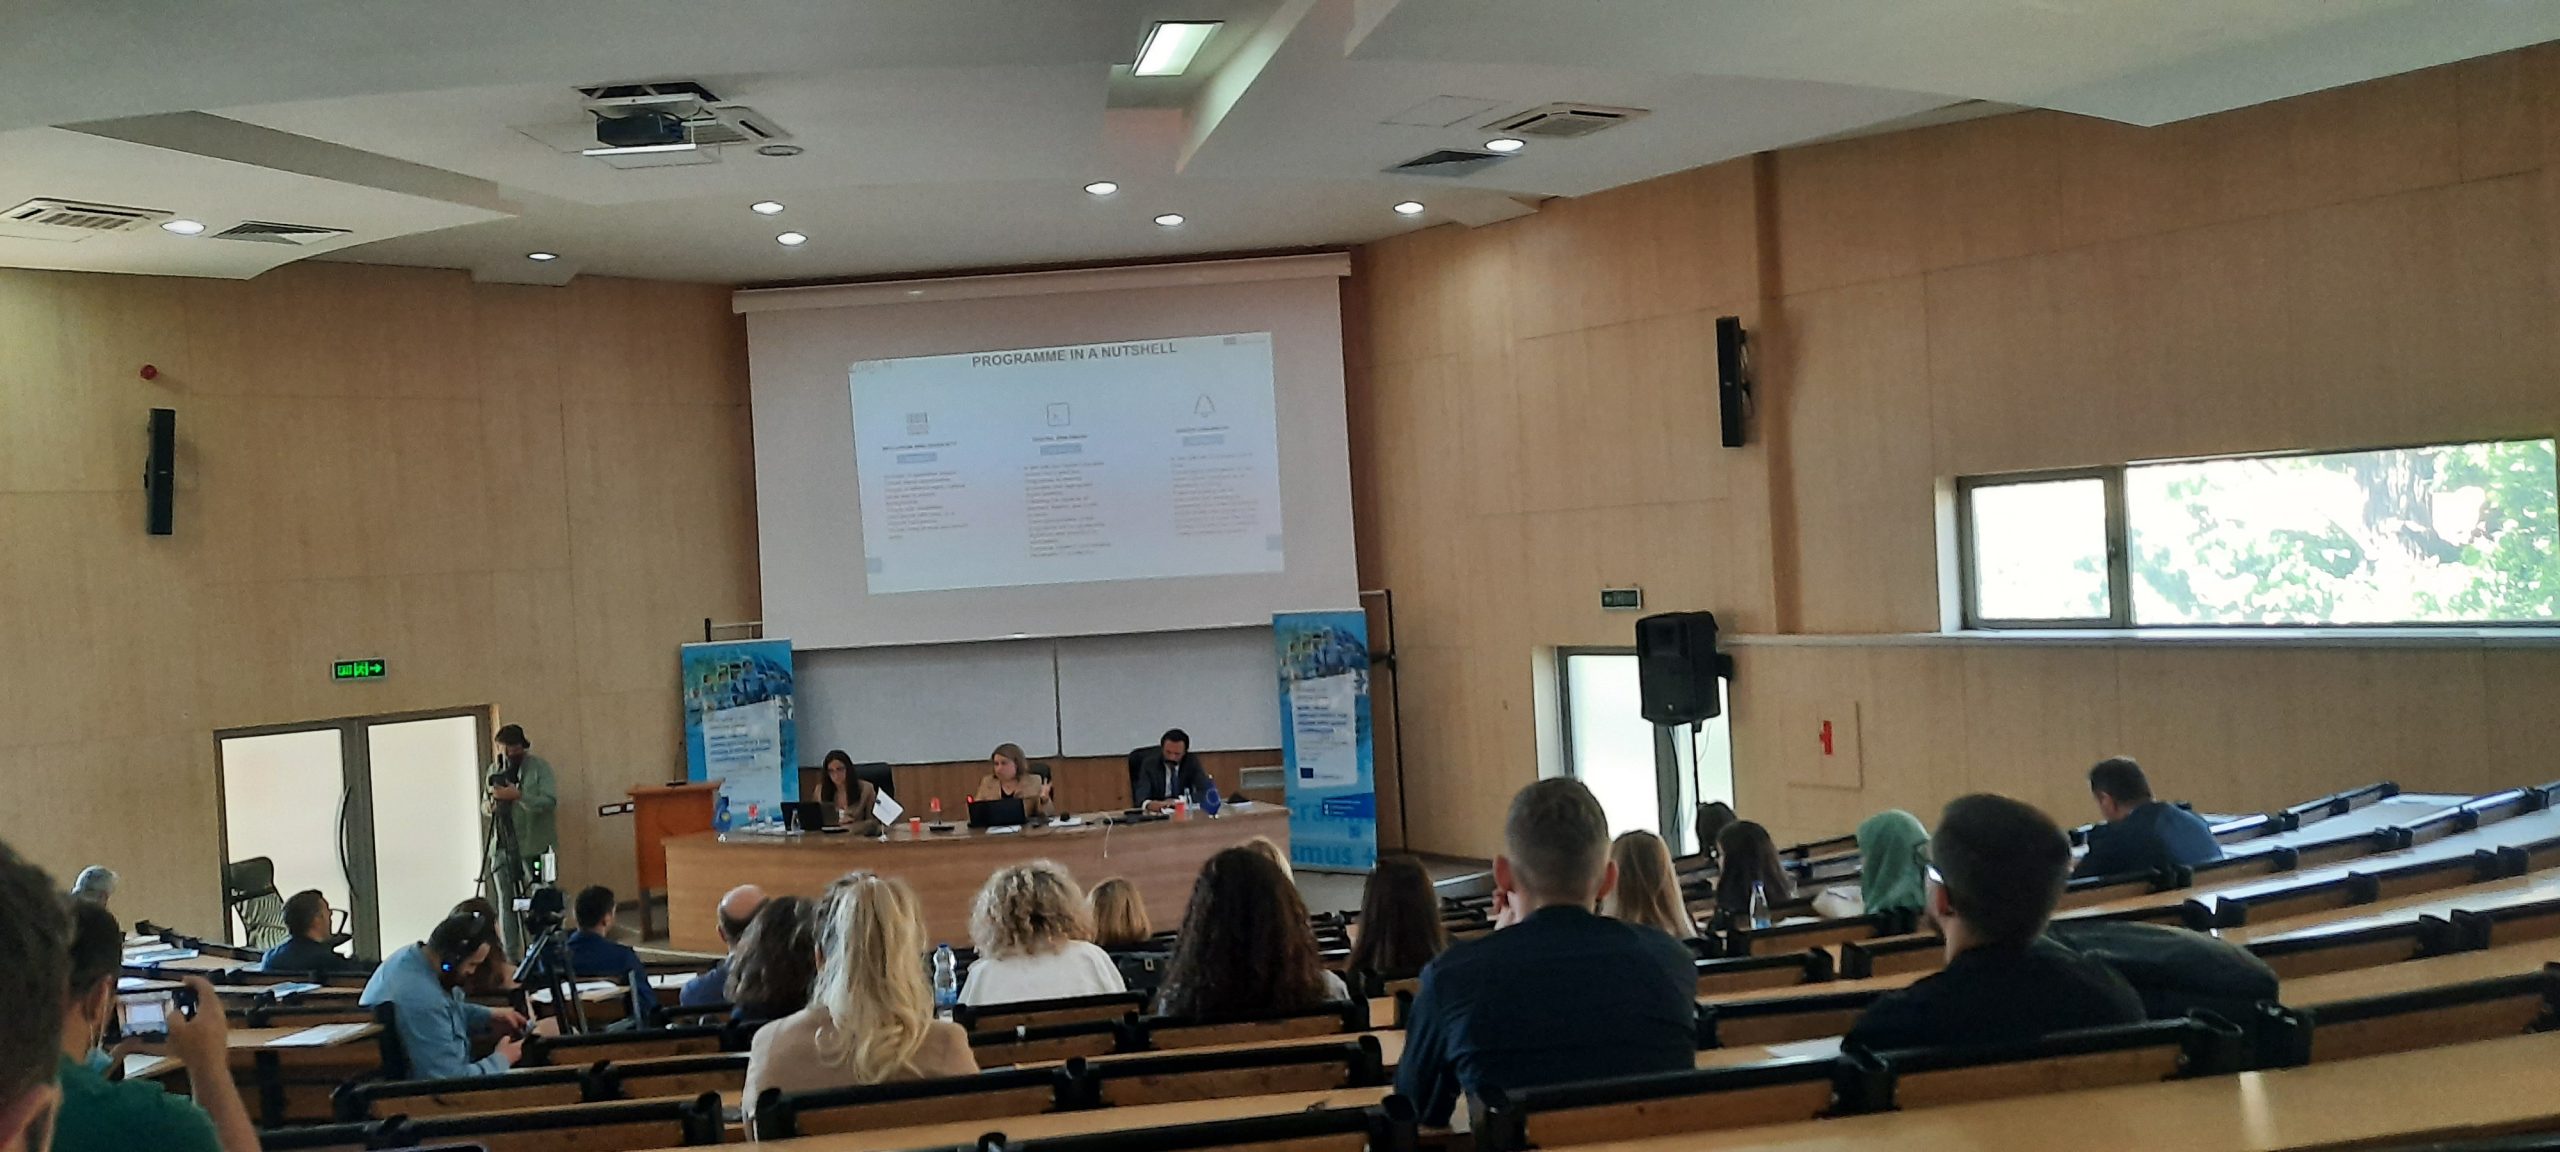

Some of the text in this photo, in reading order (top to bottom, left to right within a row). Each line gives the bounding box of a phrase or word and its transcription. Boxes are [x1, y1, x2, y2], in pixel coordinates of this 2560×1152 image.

[972, 342, 1178, 367] PROGRAMME IN A NUTSHELL
